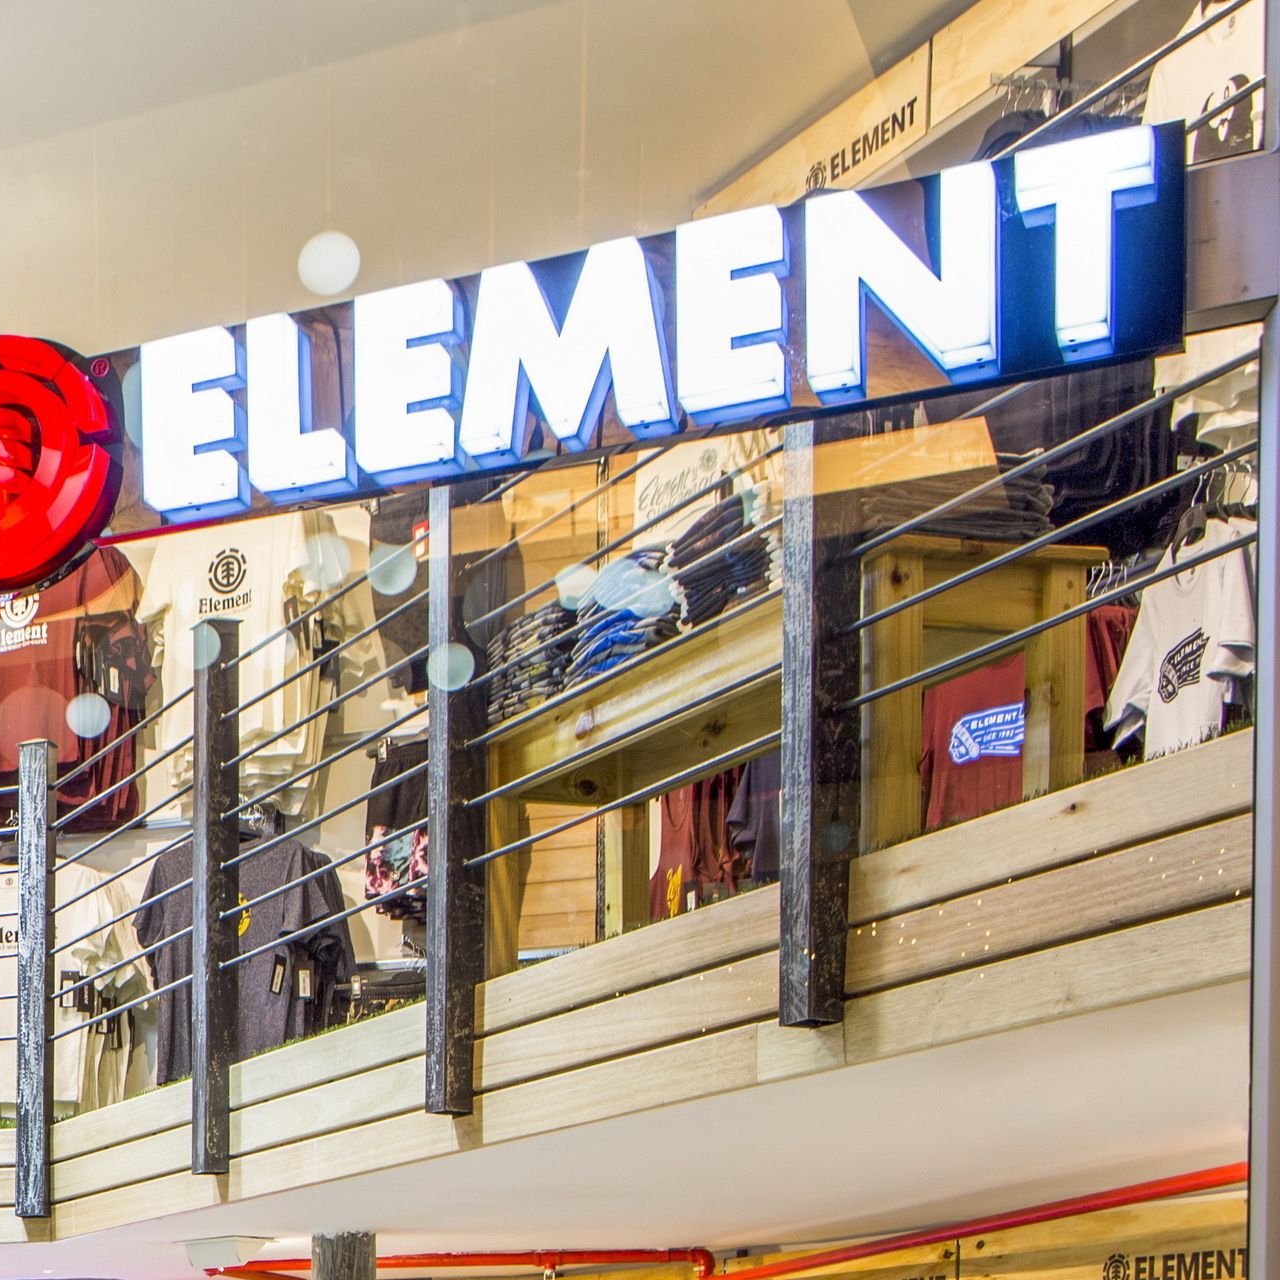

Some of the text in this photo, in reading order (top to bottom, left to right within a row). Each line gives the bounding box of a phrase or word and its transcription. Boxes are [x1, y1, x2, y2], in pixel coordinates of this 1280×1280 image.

[830, 96, 918, 182] ELEMENT
[140, 124, 1157, 522] ELEMENT
[198, 588, 252, 614] Element
[970, 711, 1018, 730] ELEMENT
